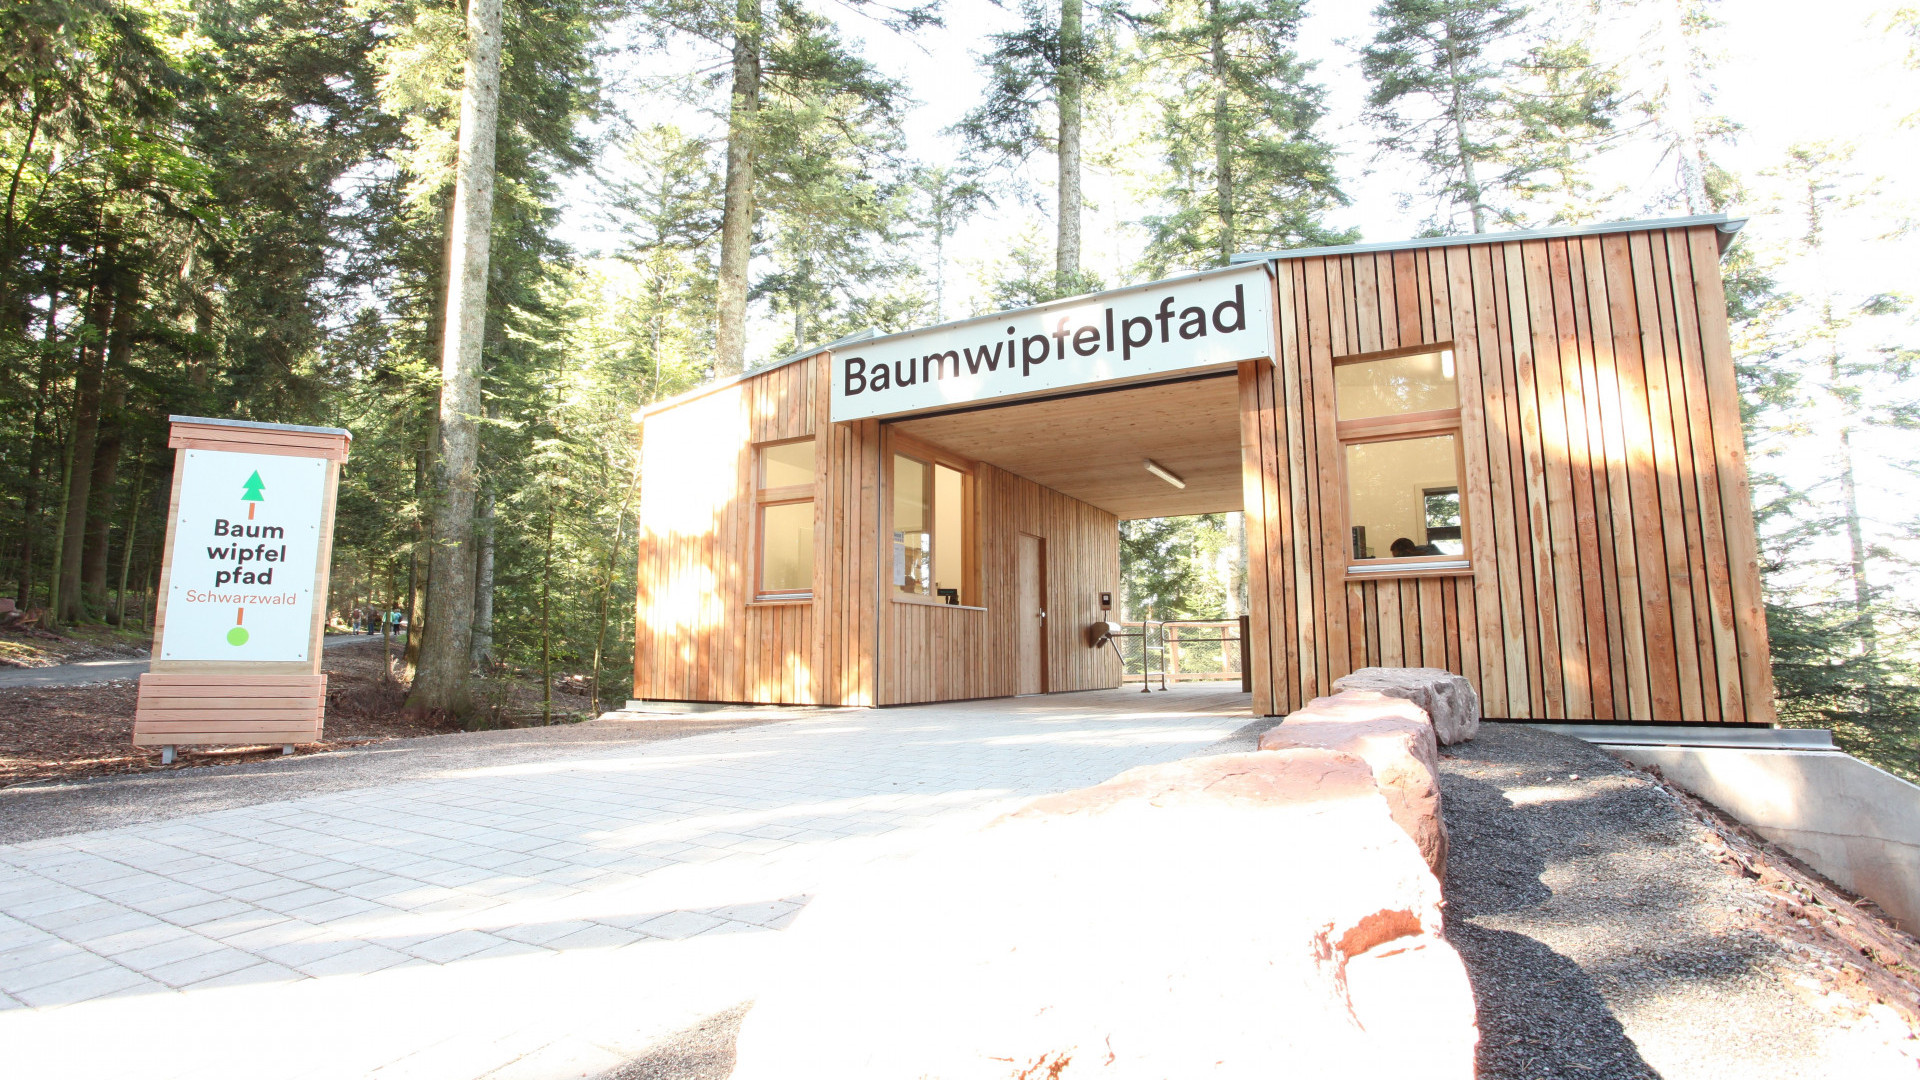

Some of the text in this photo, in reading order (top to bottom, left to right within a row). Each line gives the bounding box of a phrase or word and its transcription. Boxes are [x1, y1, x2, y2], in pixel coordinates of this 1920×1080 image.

[844, 284, 1246, 396] Baumwipfelpfad
[214, 519, 284, 539] Baum
[207, 543, 286, 565] wipfel
[215, 566, 273, 588] pfad
[186, 589, 296, 605] Schwarzwald
